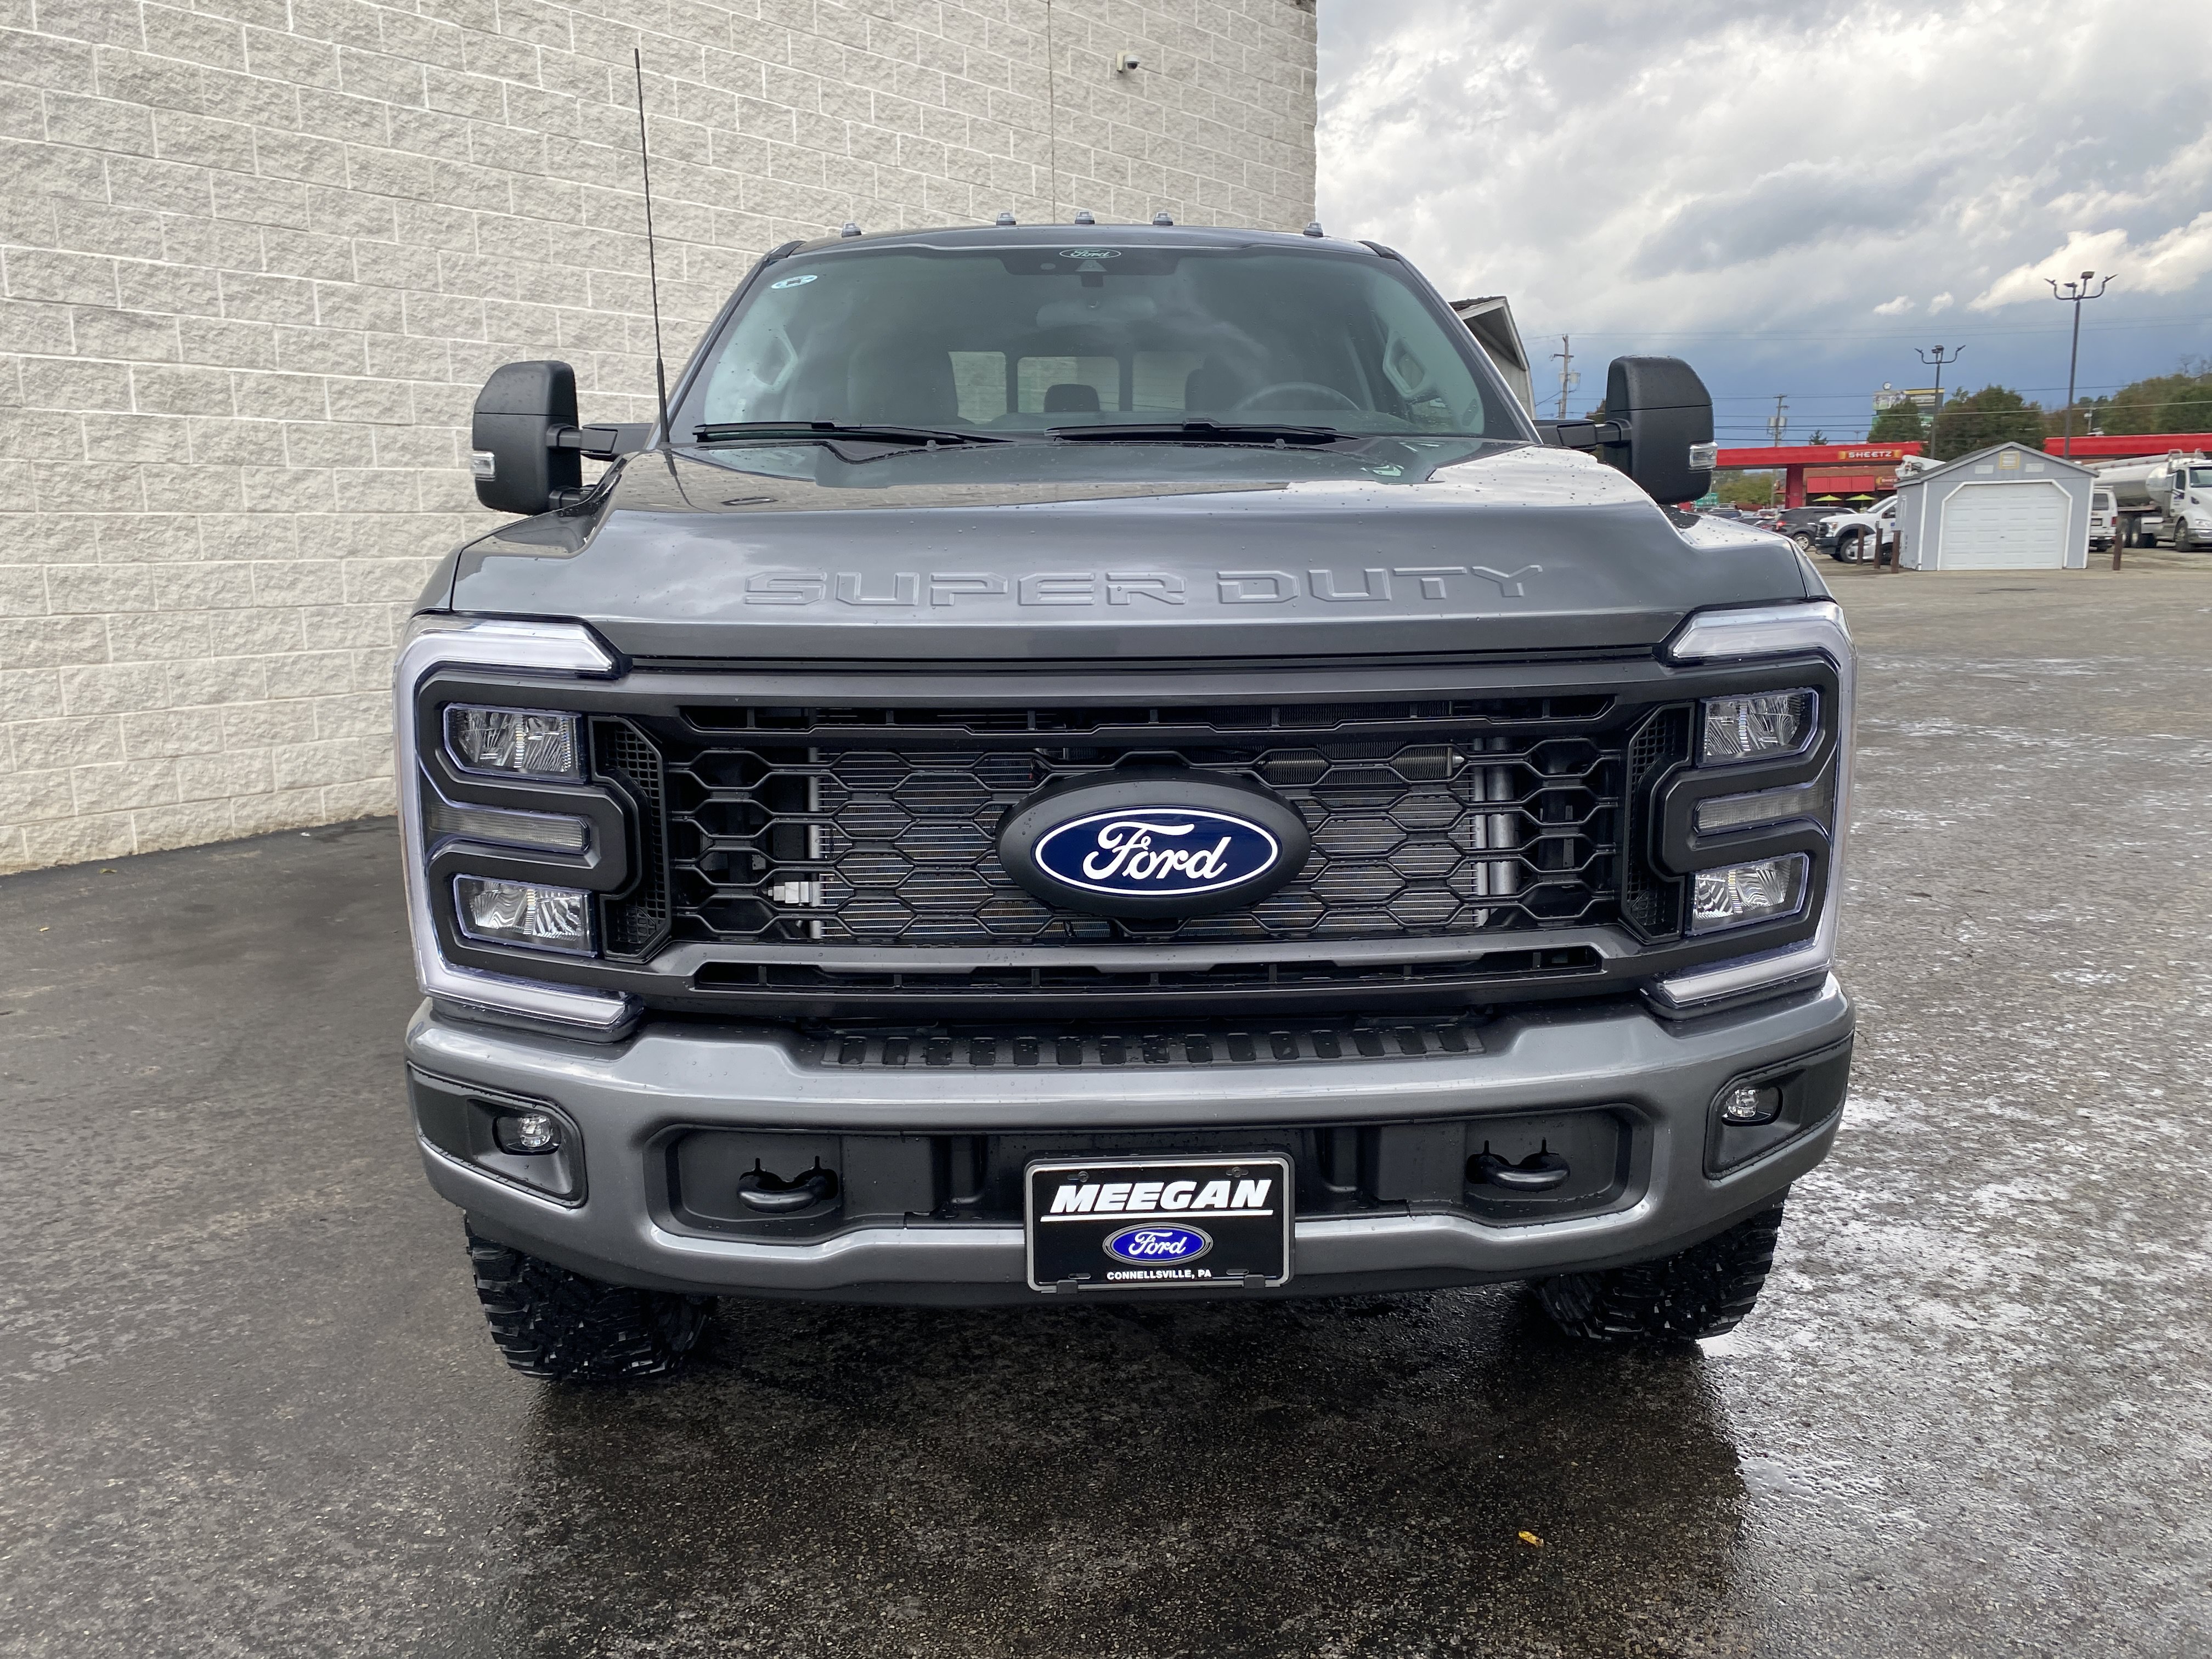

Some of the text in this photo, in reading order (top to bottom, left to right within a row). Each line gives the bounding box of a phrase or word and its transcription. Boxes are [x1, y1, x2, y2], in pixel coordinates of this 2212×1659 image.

[745, 565, 1543, 606] SUPER DUTY
[1082, 821, 1232, 880] Ford
[1049, 1180, 1272, 1214] MEEGAN
[1128, 1231, 1187, 1255] Ford
[1107, 1269, 1212, 1280] CONNELLSVILLE, PA
